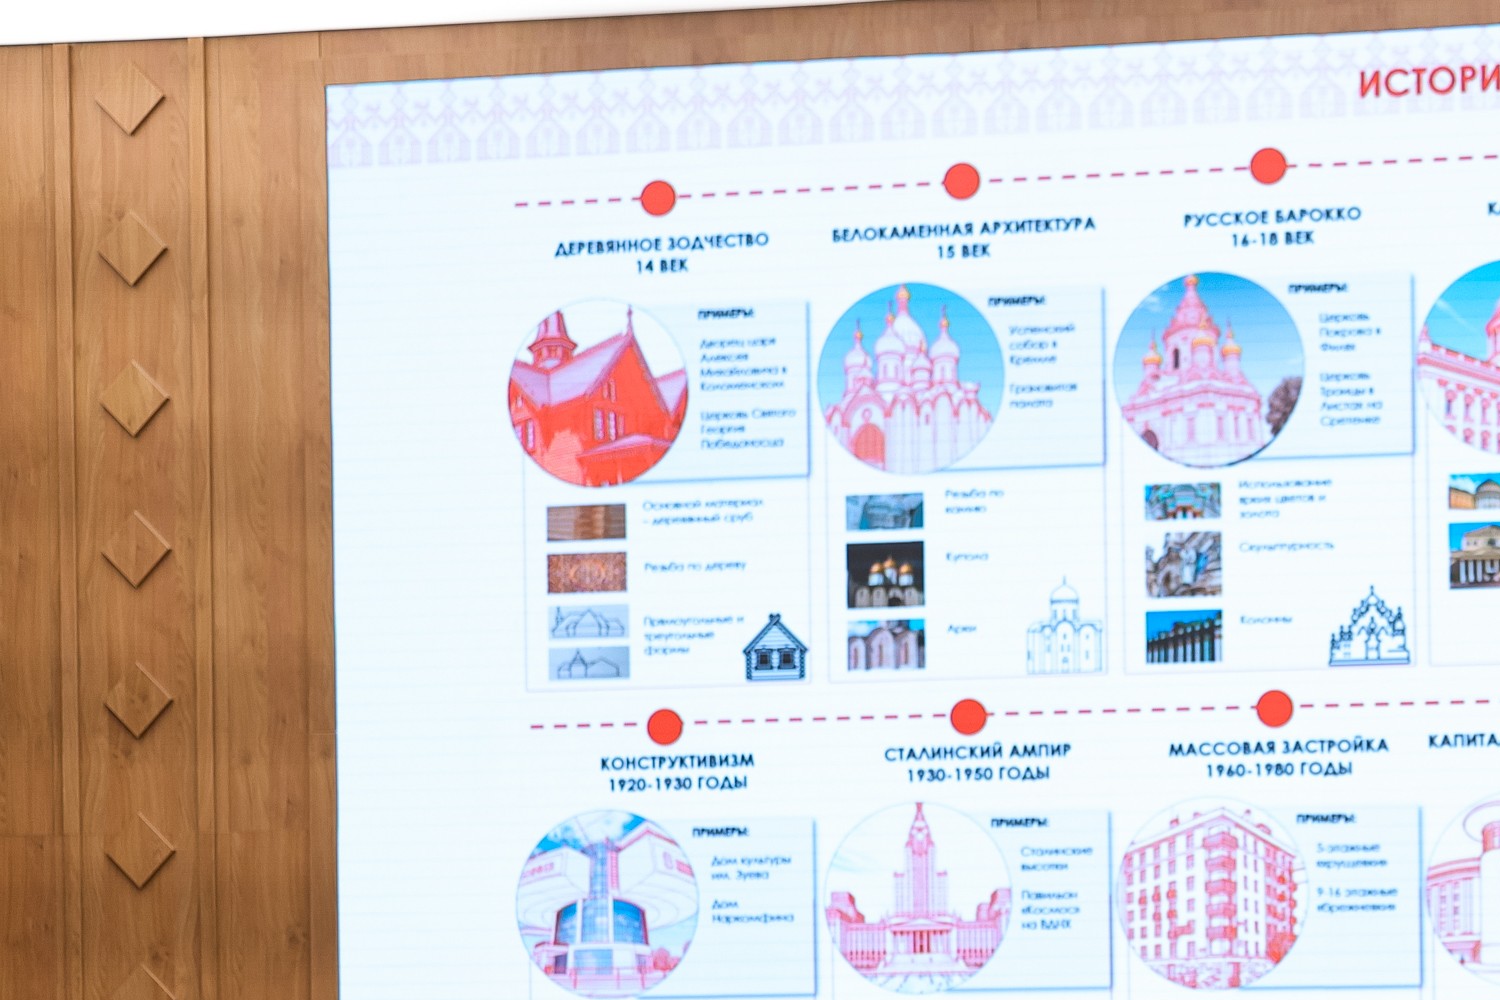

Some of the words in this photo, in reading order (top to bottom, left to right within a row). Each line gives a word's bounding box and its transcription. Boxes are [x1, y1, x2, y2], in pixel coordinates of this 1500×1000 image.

[1183, 209, 1269, 228] РУССКОЕ
[1274, 205, 1363, 225] БАРОККО
[831, 221, 974, 244] БЕЛОКАМЕННАЯ
[979, 216, 1096, 236] АРХИТЕКТУРА
[1231, 231, 1279, 248] 16-18
[1283, 229, 1315, 246] ВЕК
[553, 236, 663, 258] ДЕРЕВЯННОЕ
[667, 231, 770, 252] ЗОДЧЕСТВО
[937, 243, 956, 260] 15
[960, 242, 991, 259] ВЕК
[636, 259, 655, 274] 14
[659, 257, 689, 274] ВЕК
[884, 740, 1004, 763] СТАЛИНСКИЙ
[1008, 742, 1072, 759] АМПИР
[1168, 740, 1277, 757] МАССОВАЯ
[1281, 734, 1390, 755] ЗАСТРОЙКА
[600, 752, 755, 772] КОНСТРУКТИВИЗМ
[1206, 761, 1295, 779] 1960-1980
[1299, 760, 1353, 778] ГОДЫ
[907, 766, 994, 783] 1930-1950
[998, 765, 1051, 782] ГОДЫ
[609, 775, 693, 793] 1920-1930
[697, 775, 748, 791] ГОДЫ
